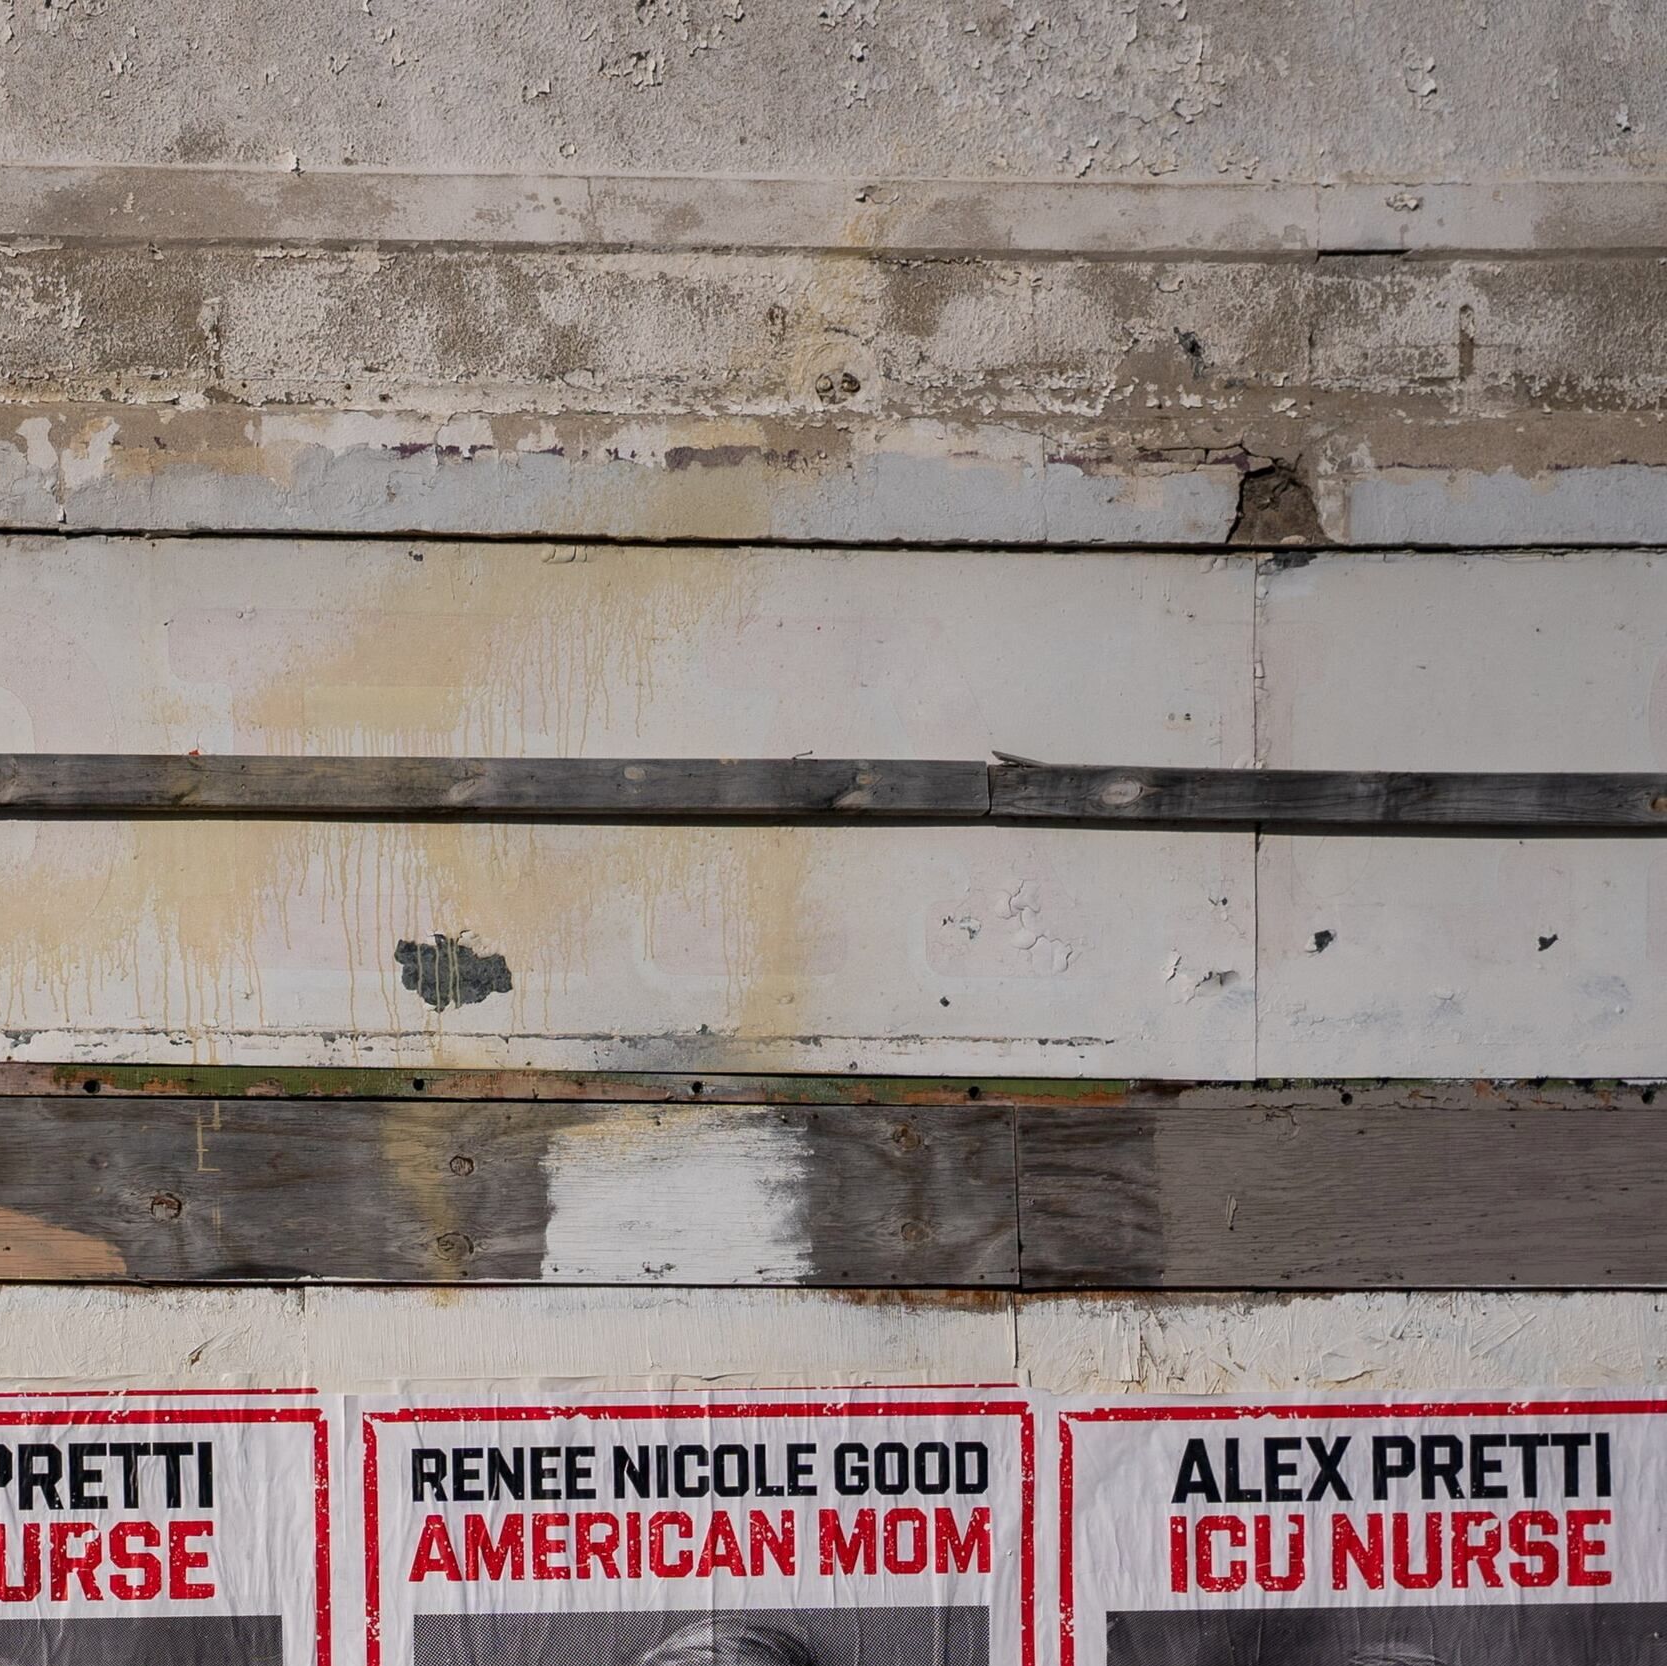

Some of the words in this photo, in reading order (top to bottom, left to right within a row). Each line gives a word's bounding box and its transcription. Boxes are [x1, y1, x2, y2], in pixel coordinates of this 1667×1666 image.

[411, 1446, 597, 1502] RENEE
[613, 1443, 818, 1499] NICOLE
[834, 1441, 989, 1496] GOOD
[1171, 1436, 1353, 1504] ALEX
[1372, 1432, 1612, 1501] PRETTI
[408, 1509, 796, 1583] AMERICAN
[818, 1506, 991, 1576] MOM
[1169, 1513, 1306, 1594] ICU
[1331, 1509, 1612, 1591] NURSE
